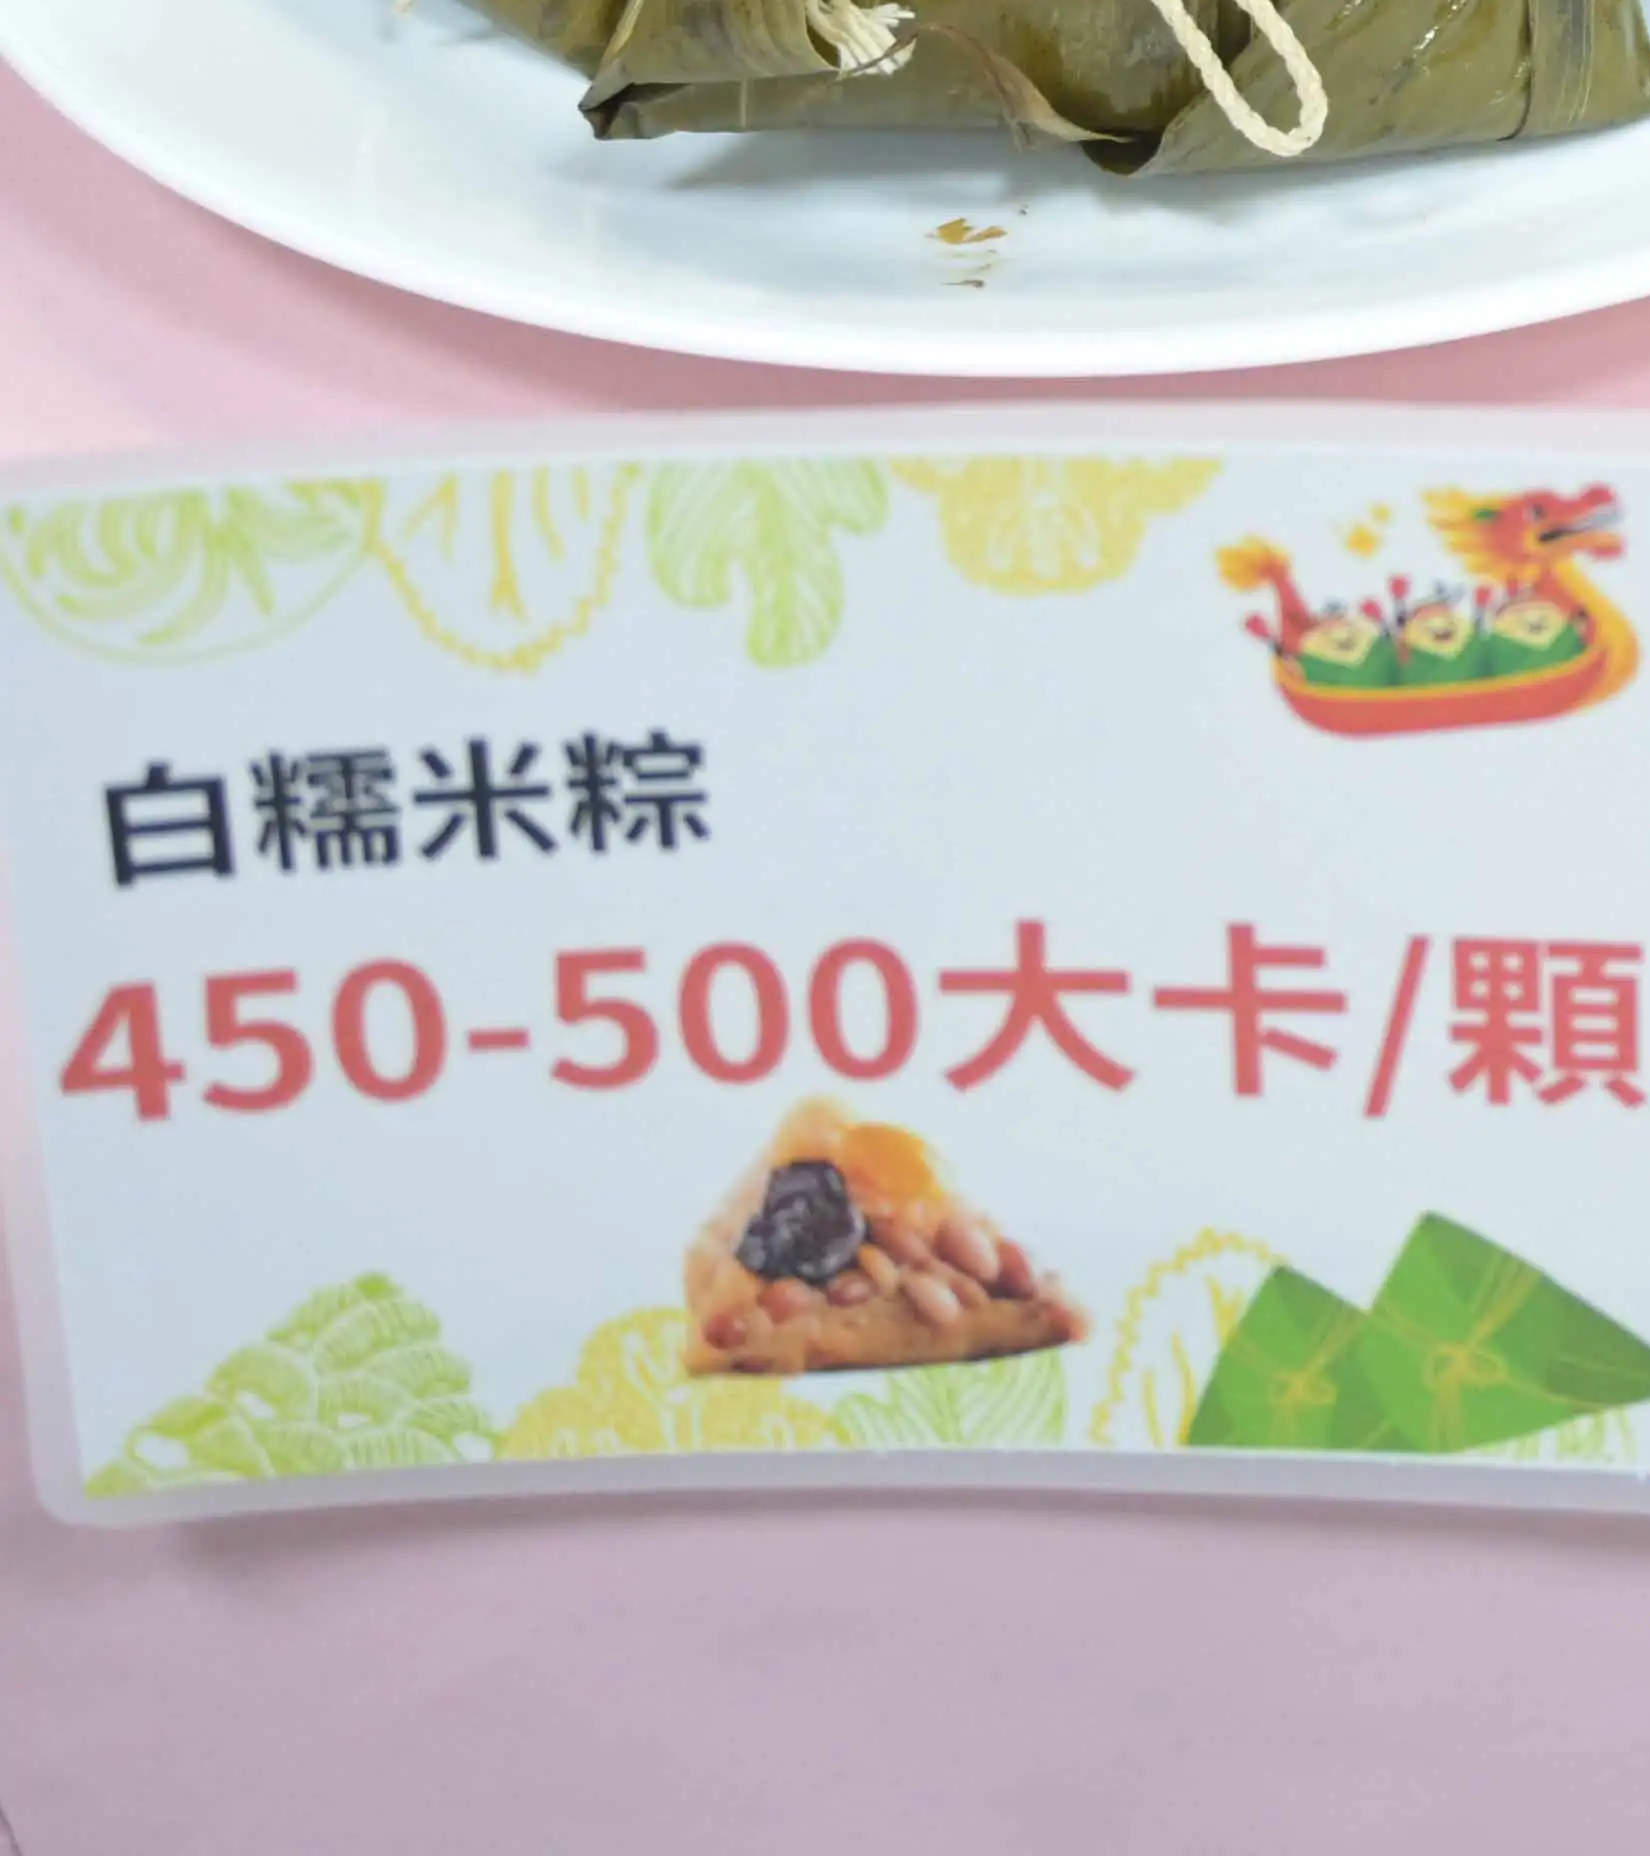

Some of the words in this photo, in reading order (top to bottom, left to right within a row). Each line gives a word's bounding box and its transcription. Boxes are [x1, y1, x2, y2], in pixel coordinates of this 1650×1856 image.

[103, 730, 708, 888] 白糯米粽
[61, 921, 1644, 1119] 450-500大卡/顆
